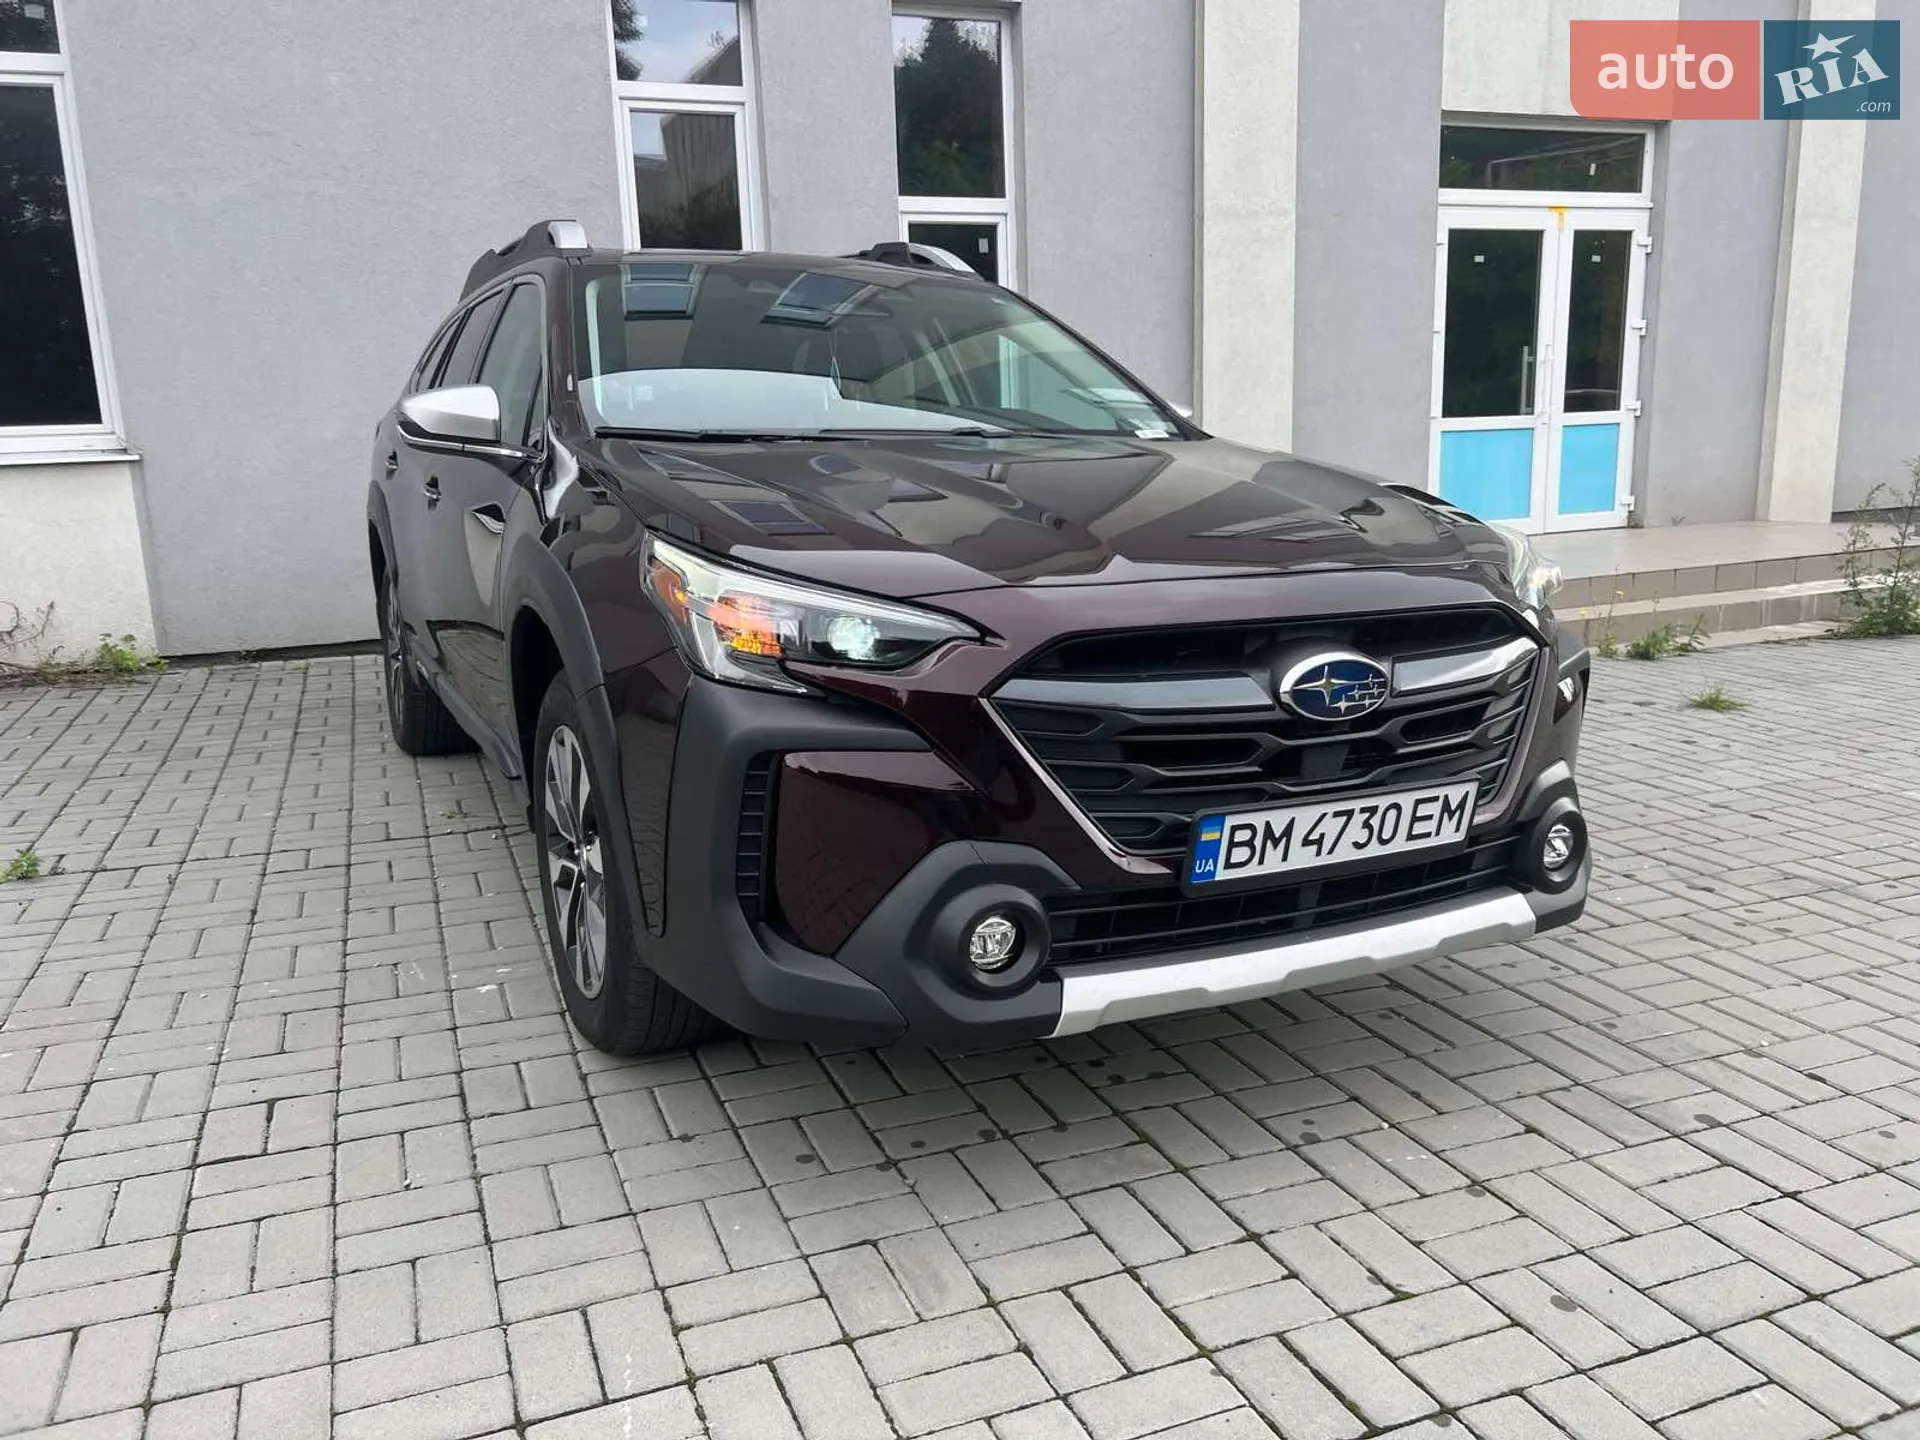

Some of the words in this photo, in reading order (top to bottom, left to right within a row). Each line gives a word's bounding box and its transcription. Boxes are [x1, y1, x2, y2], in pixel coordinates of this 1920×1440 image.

[1223, 815, 1296, 870] BM
[1301, 802, 1403, 857] 4730
[1406, 790, 1471, 842] EM
[1195, 859, 1215, 874] UA
